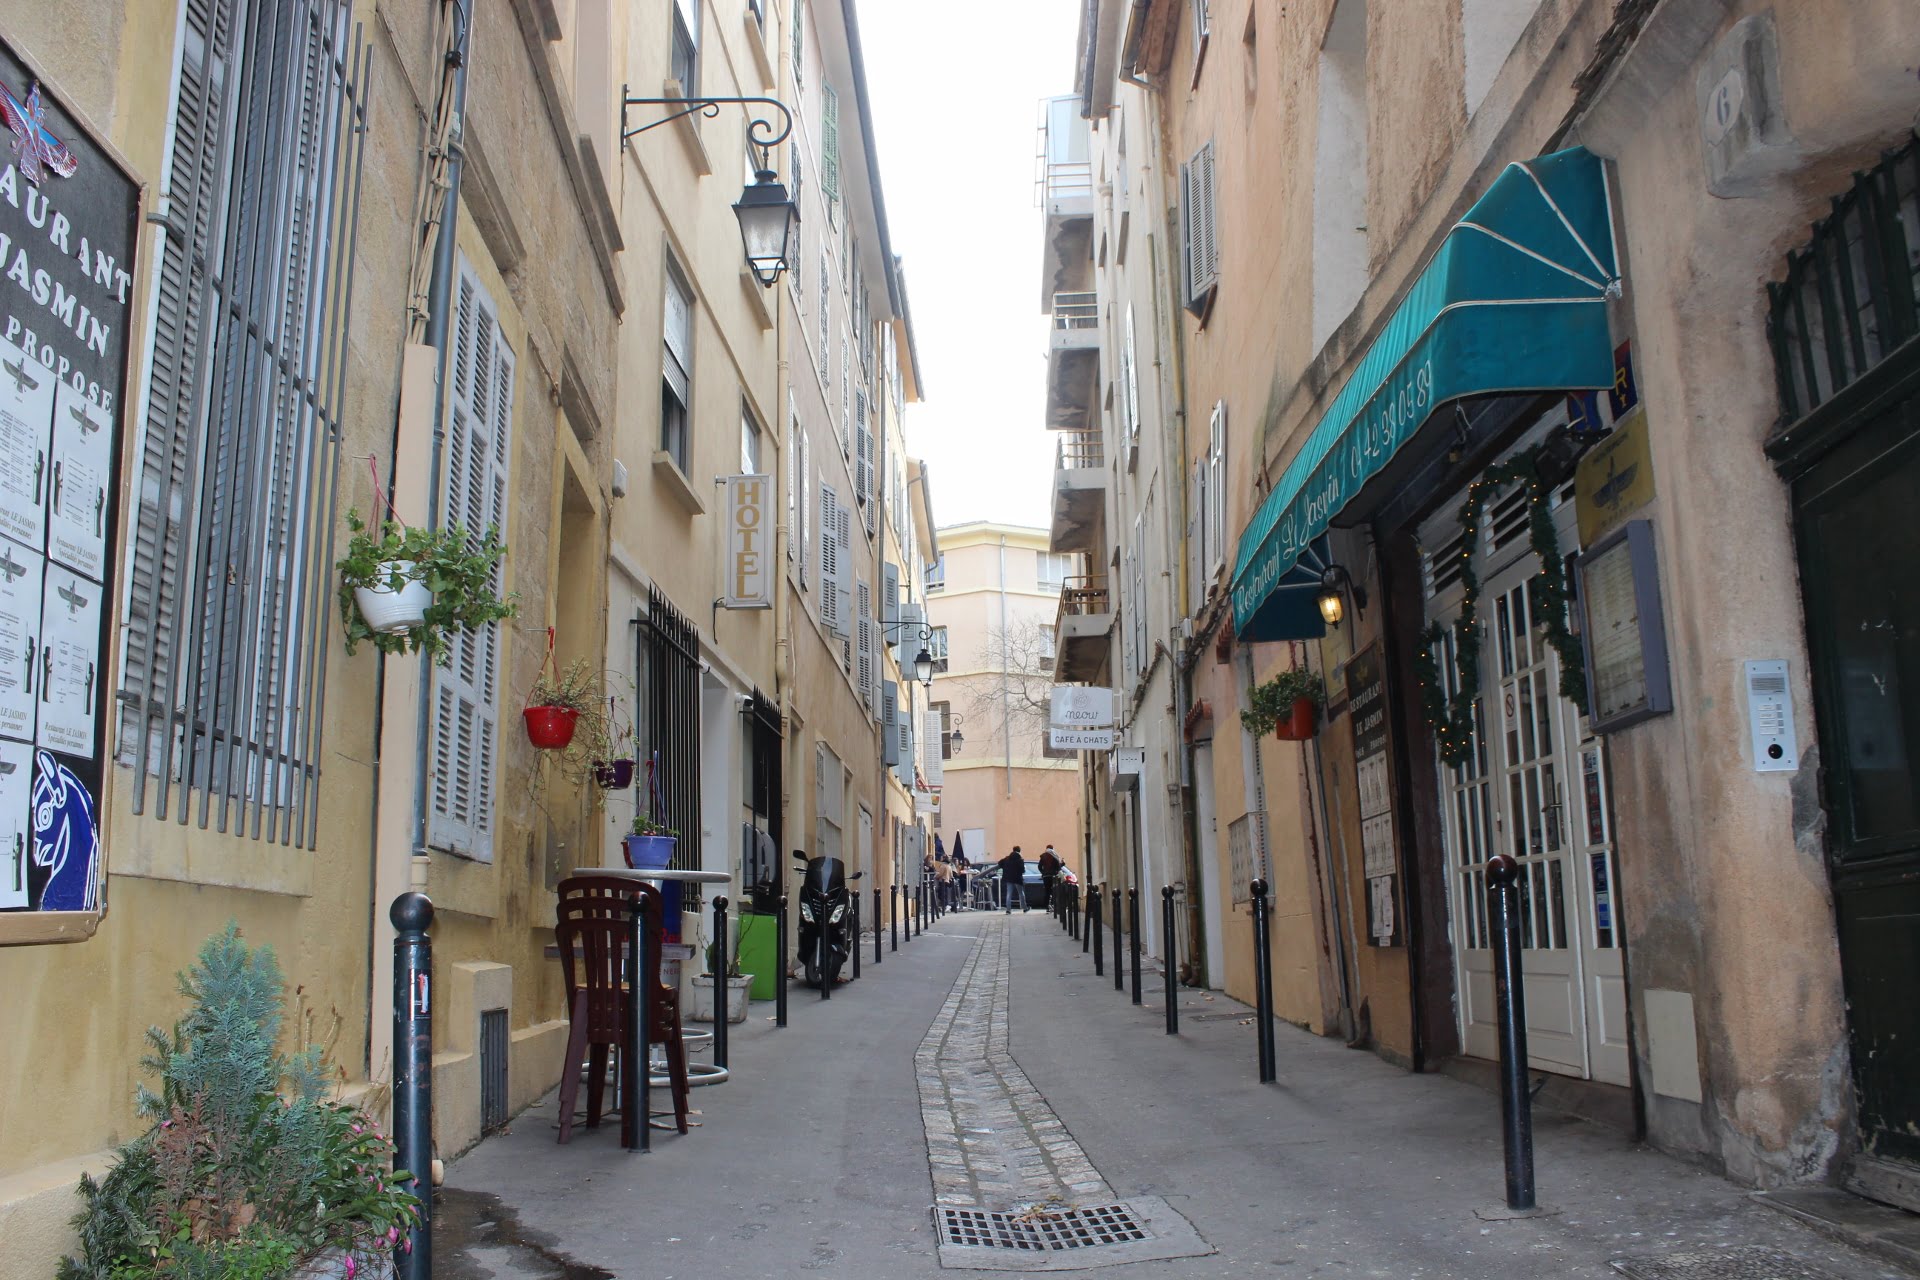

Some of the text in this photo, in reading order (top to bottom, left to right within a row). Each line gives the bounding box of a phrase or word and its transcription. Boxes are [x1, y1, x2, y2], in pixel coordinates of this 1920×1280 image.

[6, 315, 113, 413] PROPOSE
[735, 481, 760, 599] HOTEL
[1084, 736, 1109, 744] CHATS
